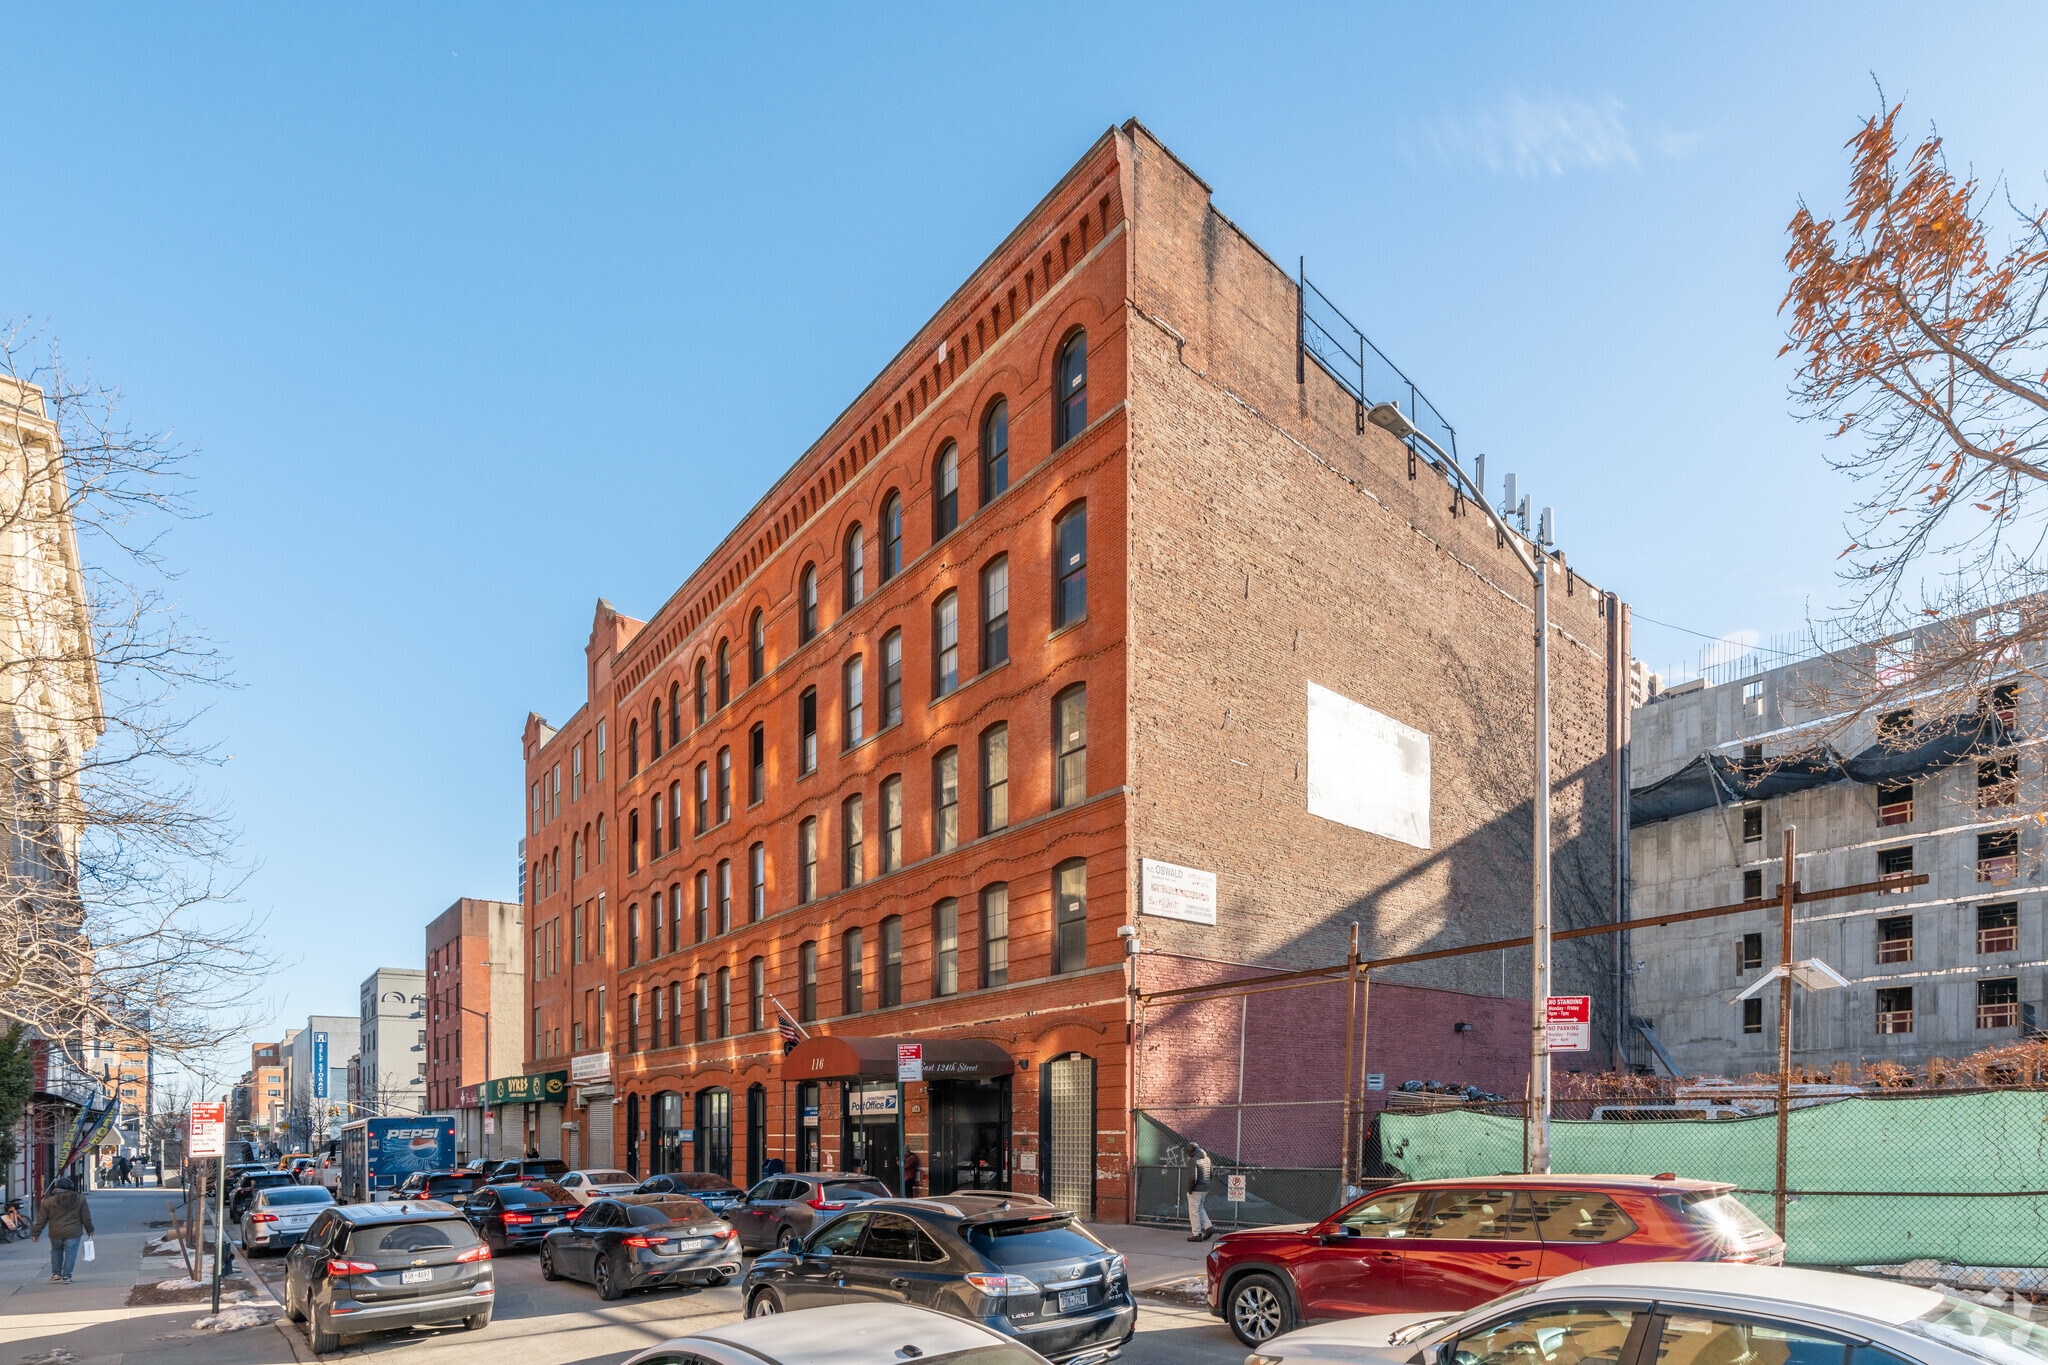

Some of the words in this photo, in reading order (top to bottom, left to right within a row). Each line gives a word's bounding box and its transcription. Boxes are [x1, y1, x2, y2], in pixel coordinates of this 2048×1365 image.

[1155, 865, 1183, 878] OSWALD
[812, 1058, 824, 1070] 116
[937, 1061, 957, 1072] 124th
[957, 1061, 978, 1072] Street
[508, 1078, 528, 1092] DYKES
[866, 1101, 884, 1110] Office
[387, 1128, 439, 1140] PEPSI
